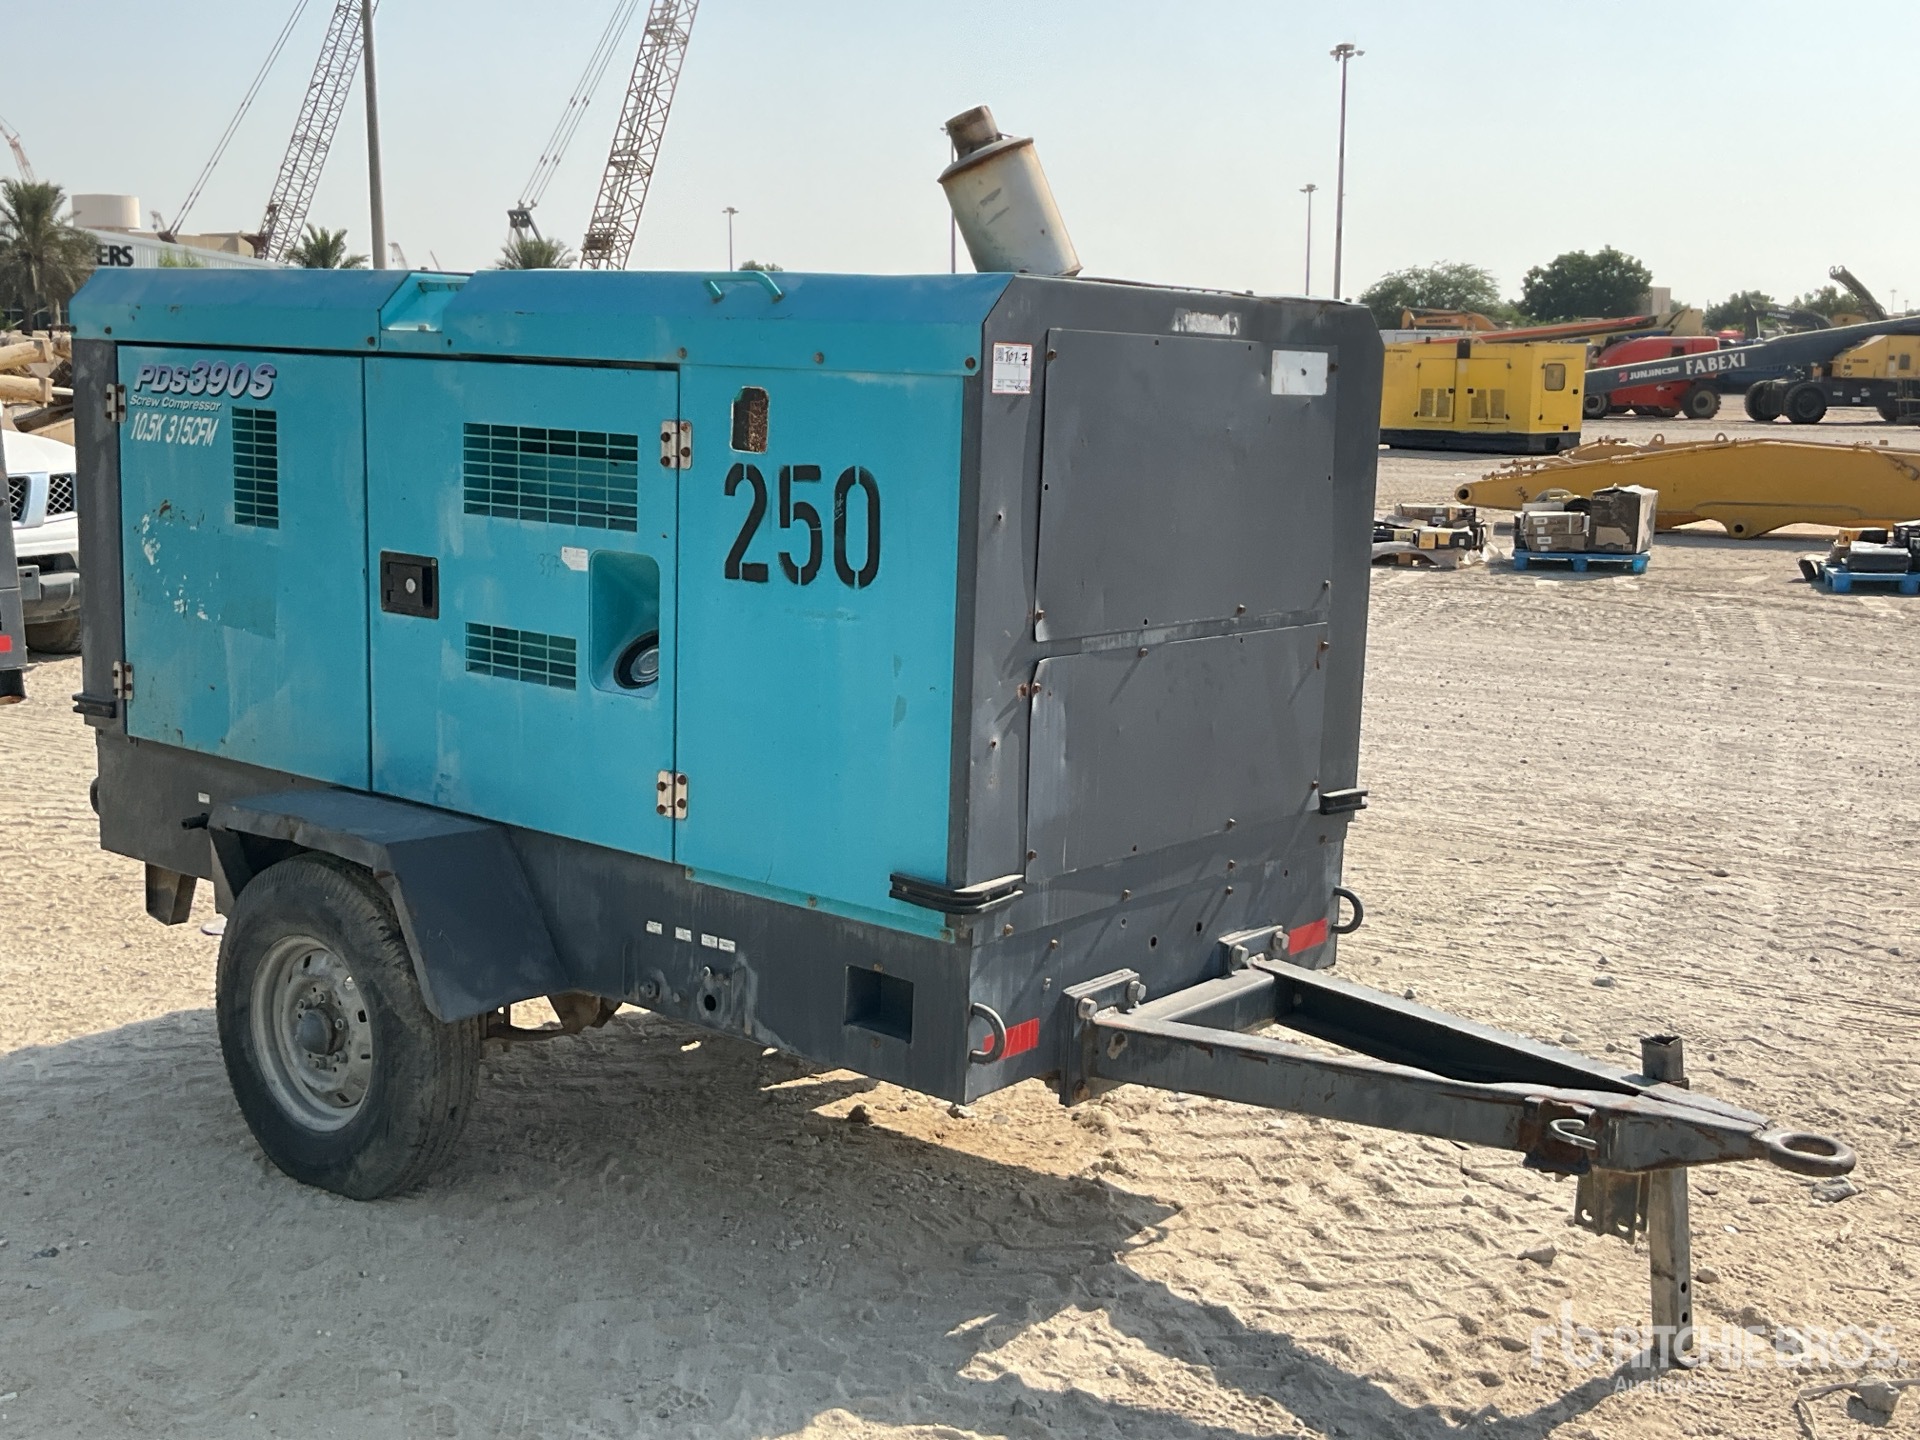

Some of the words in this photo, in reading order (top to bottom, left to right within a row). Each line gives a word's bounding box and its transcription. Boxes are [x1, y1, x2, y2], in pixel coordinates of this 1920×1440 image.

[133, 359, 278, 400] PDS390S
[1685, 352, 1746, 375] FABEXI
[130, 394, 162, 407] Screw
[161, 396, 222, 412] Compressor
[130, 411, 167, 443] 10.5K
[165, 413, 220, 447] 315CFM
[724, 462, 880, 590] 250
